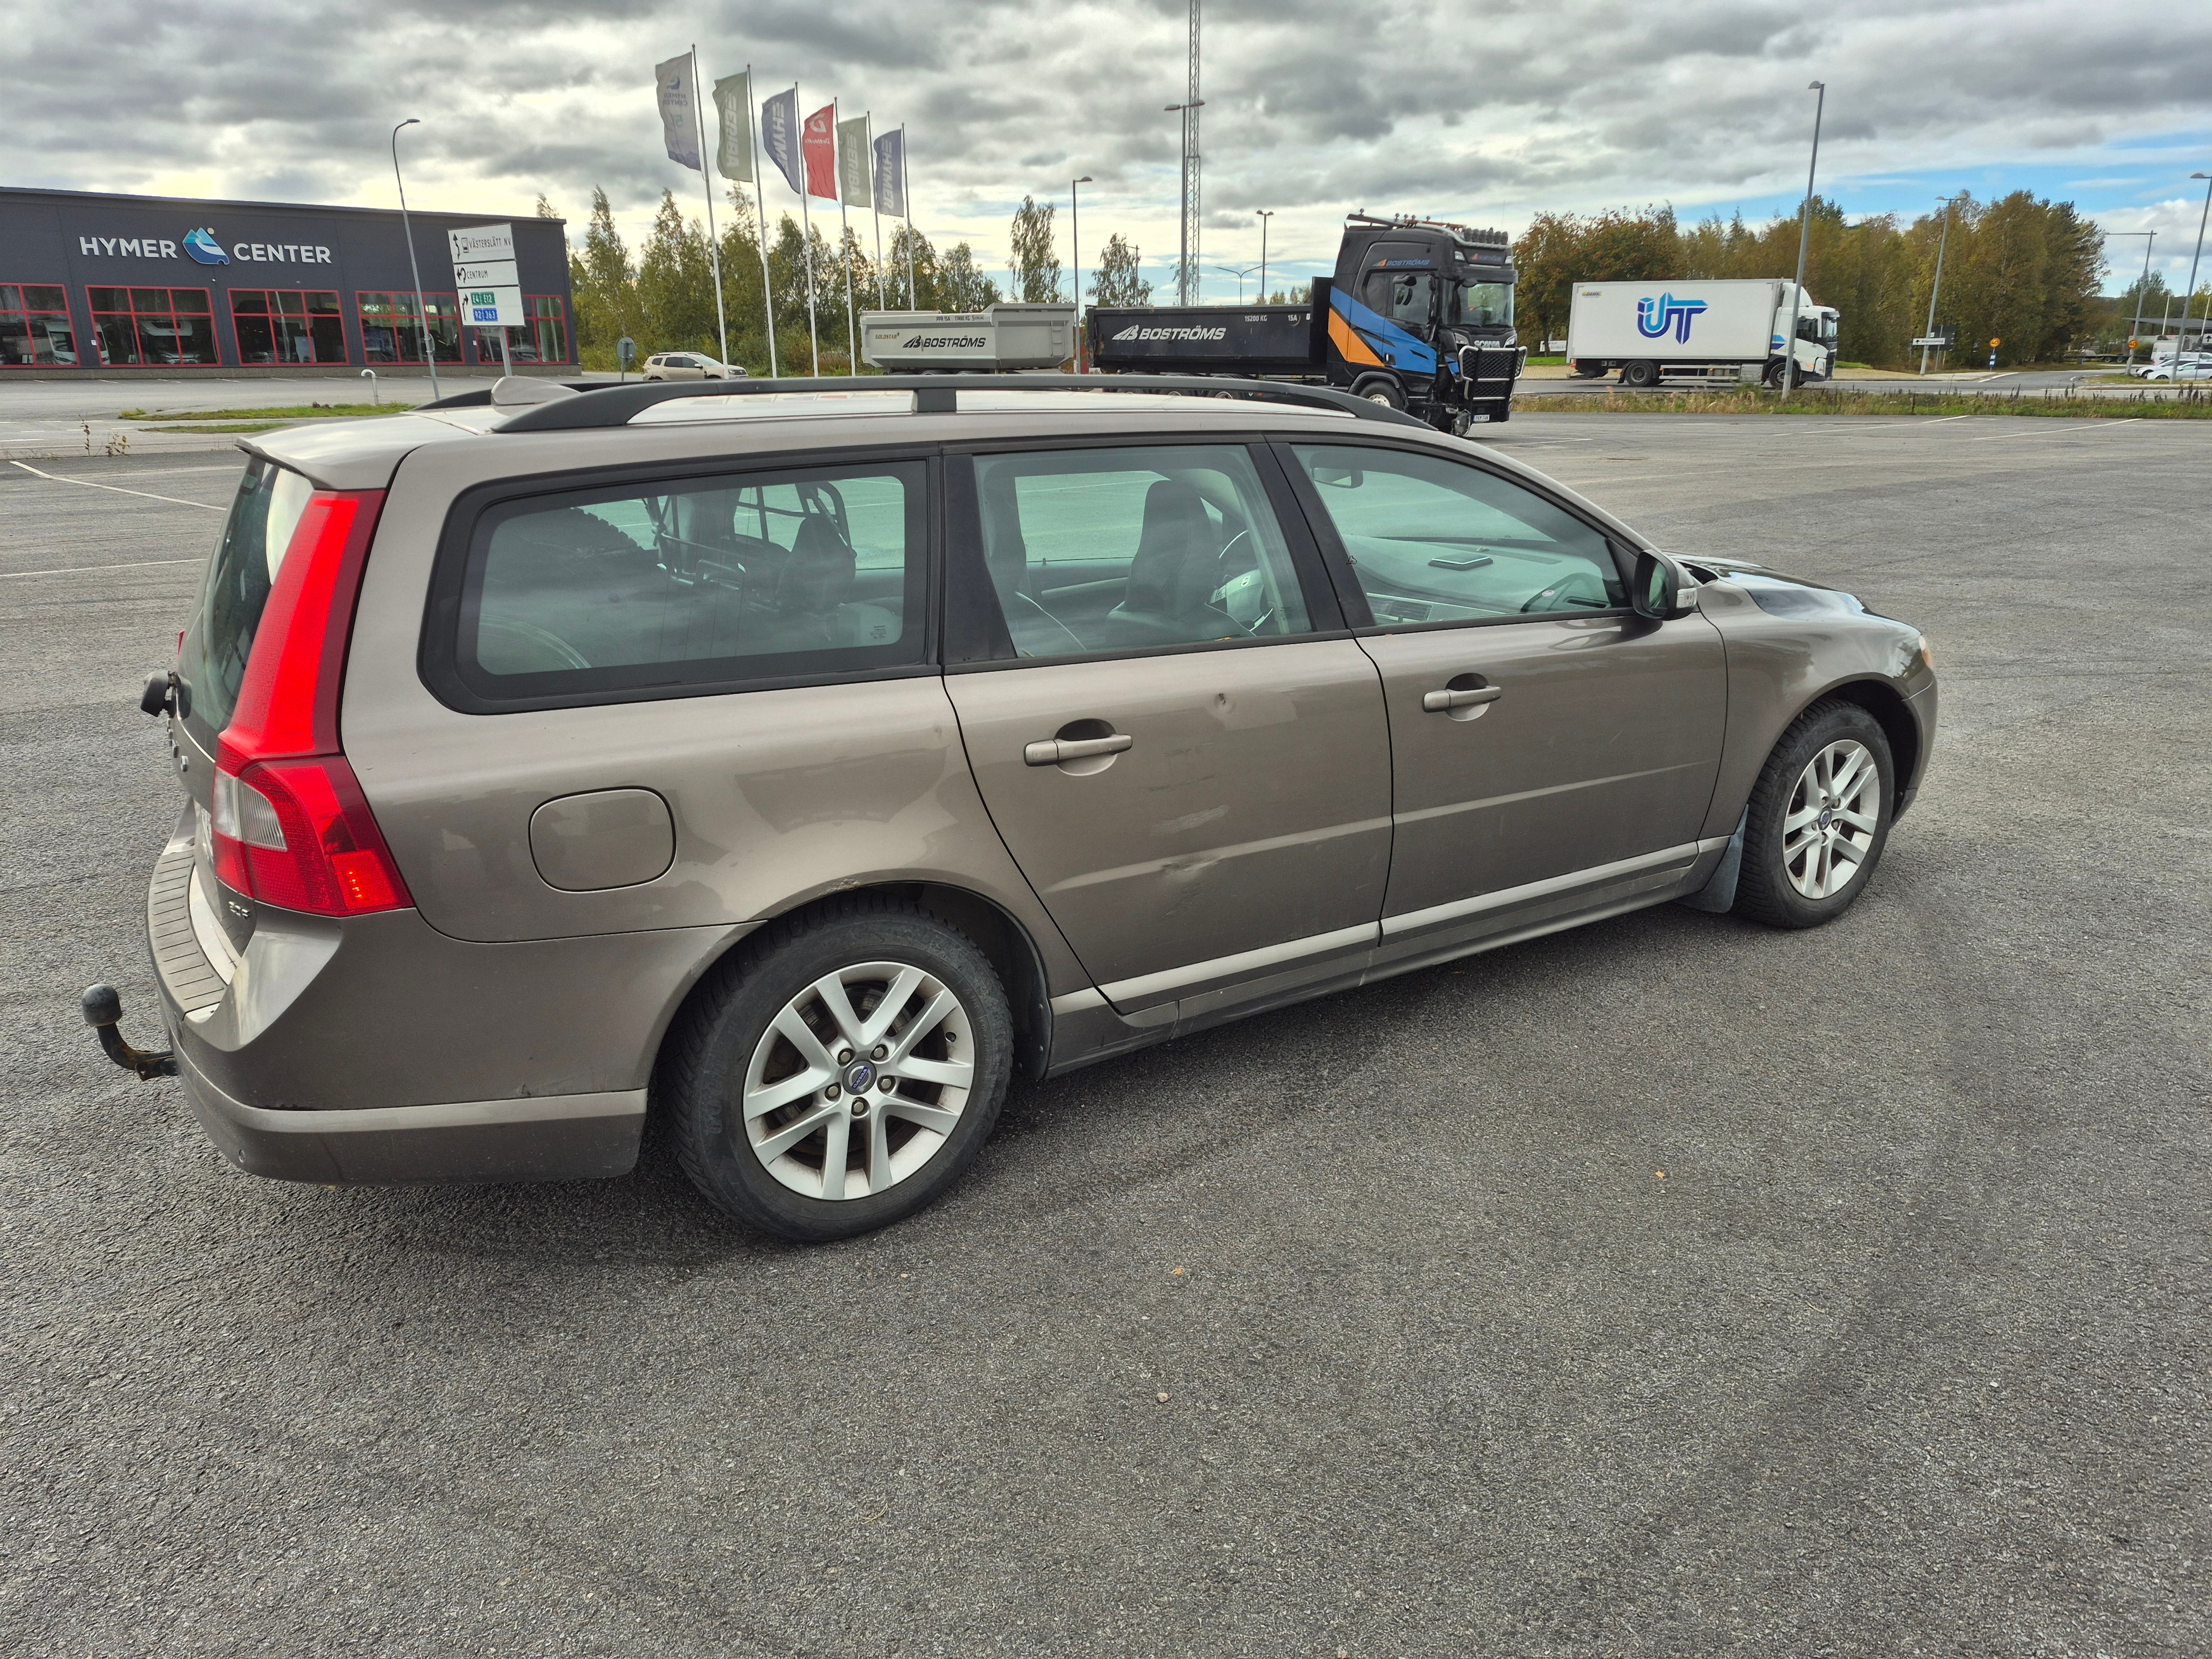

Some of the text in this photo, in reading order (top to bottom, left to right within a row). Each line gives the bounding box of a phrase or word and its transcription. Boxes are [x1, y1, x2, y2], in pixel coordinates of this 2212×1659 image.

[725, 108, 739, 167] ERIBA
[847, 148, 860, 196] ERIBA
[882, 152, 894, 209] HYMER
[469, 236, 511, 249] VÄSTERSLÄTT NV
[79, 236, 332, 264] HYMER CENTER
[467, 270, 488, 279] CENTRUM
[472, 294, 493, 303] E4 E12
[474, 310, 495, 319] 92 363
[1139, 325, 1227, 340] BOSTRÖMS
[923, 335, 986, 348] BOSTRÖMS
[1474, 340, 1500, 348] SCANIA
[853, 1068, 868, 1088] VOLVO
